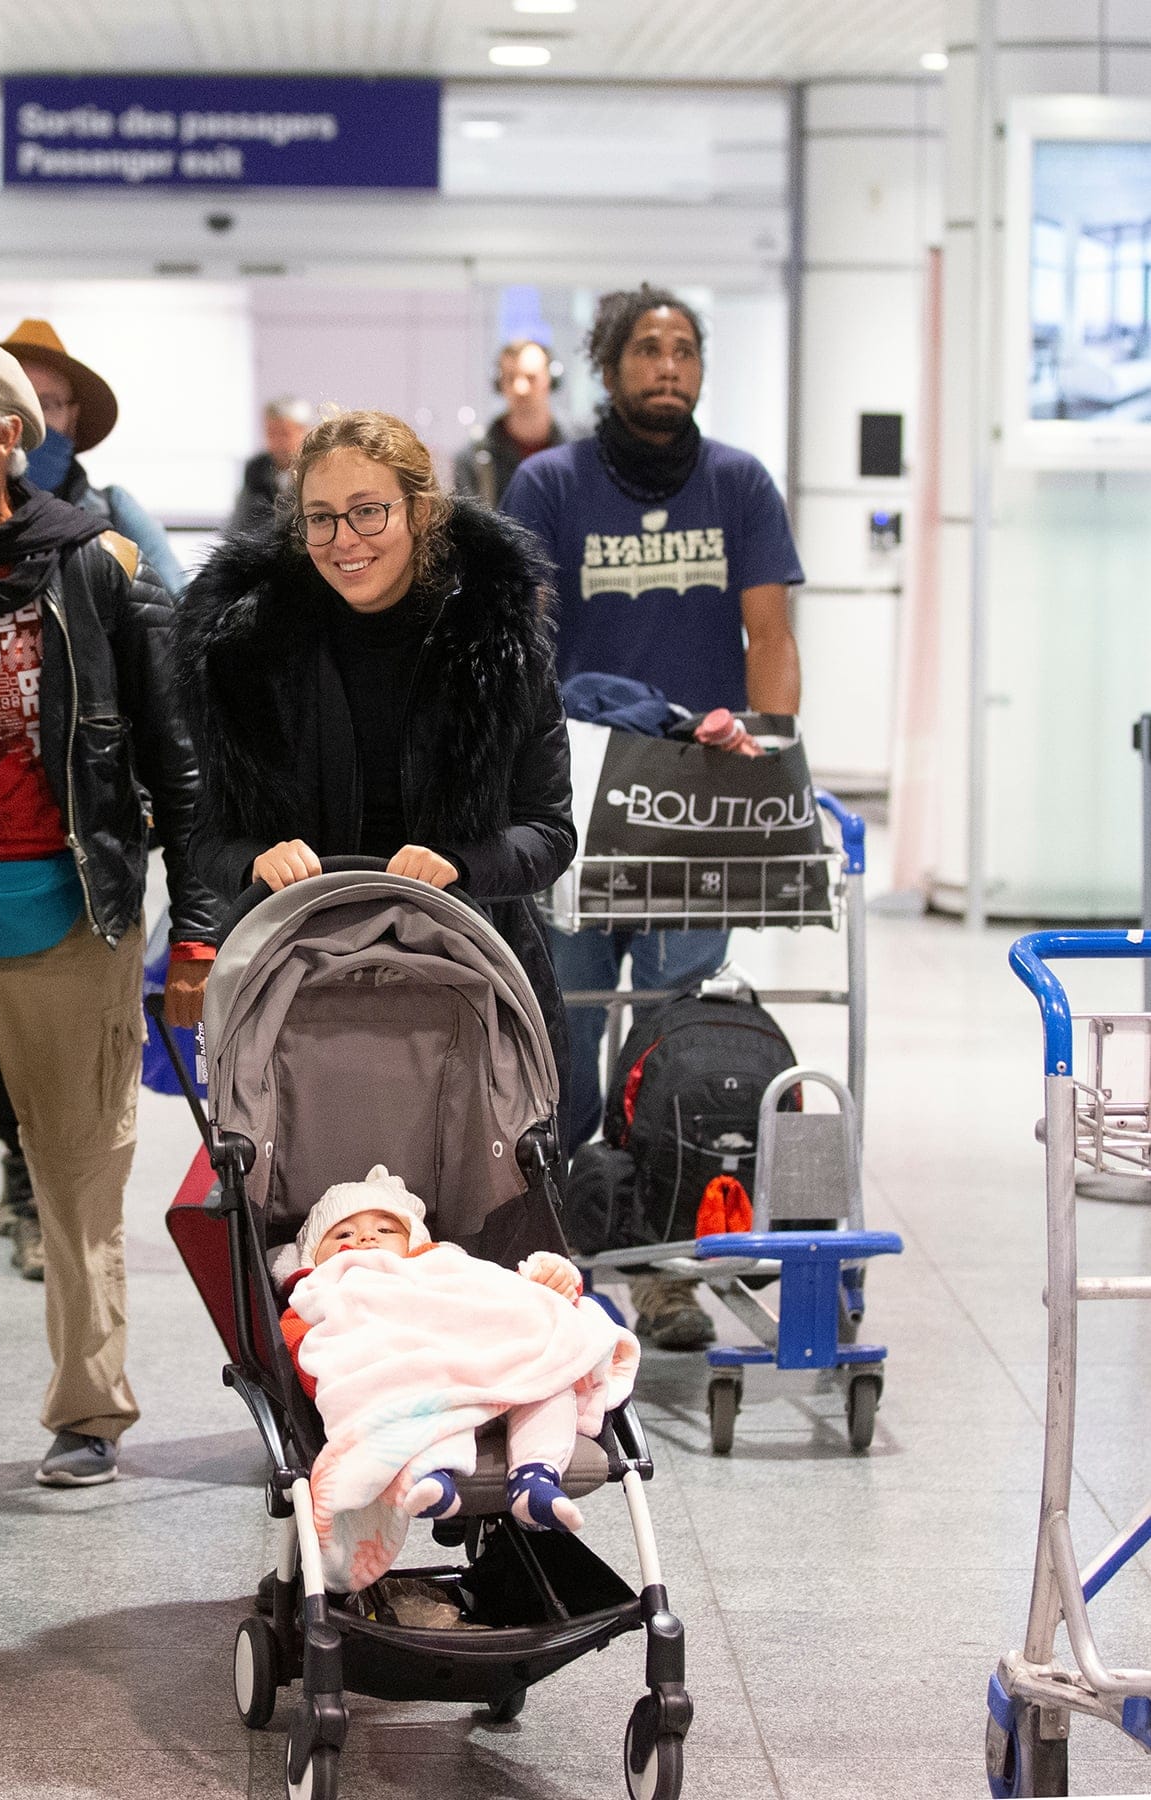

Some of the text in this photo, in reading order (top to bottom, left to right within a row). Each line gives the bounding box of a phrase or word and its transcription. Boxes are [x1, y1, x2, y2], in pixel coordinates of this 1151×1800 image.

[18, 105, 337, 145] Sortie des passagers
[18, 143, 244, 181] Passenger exit
